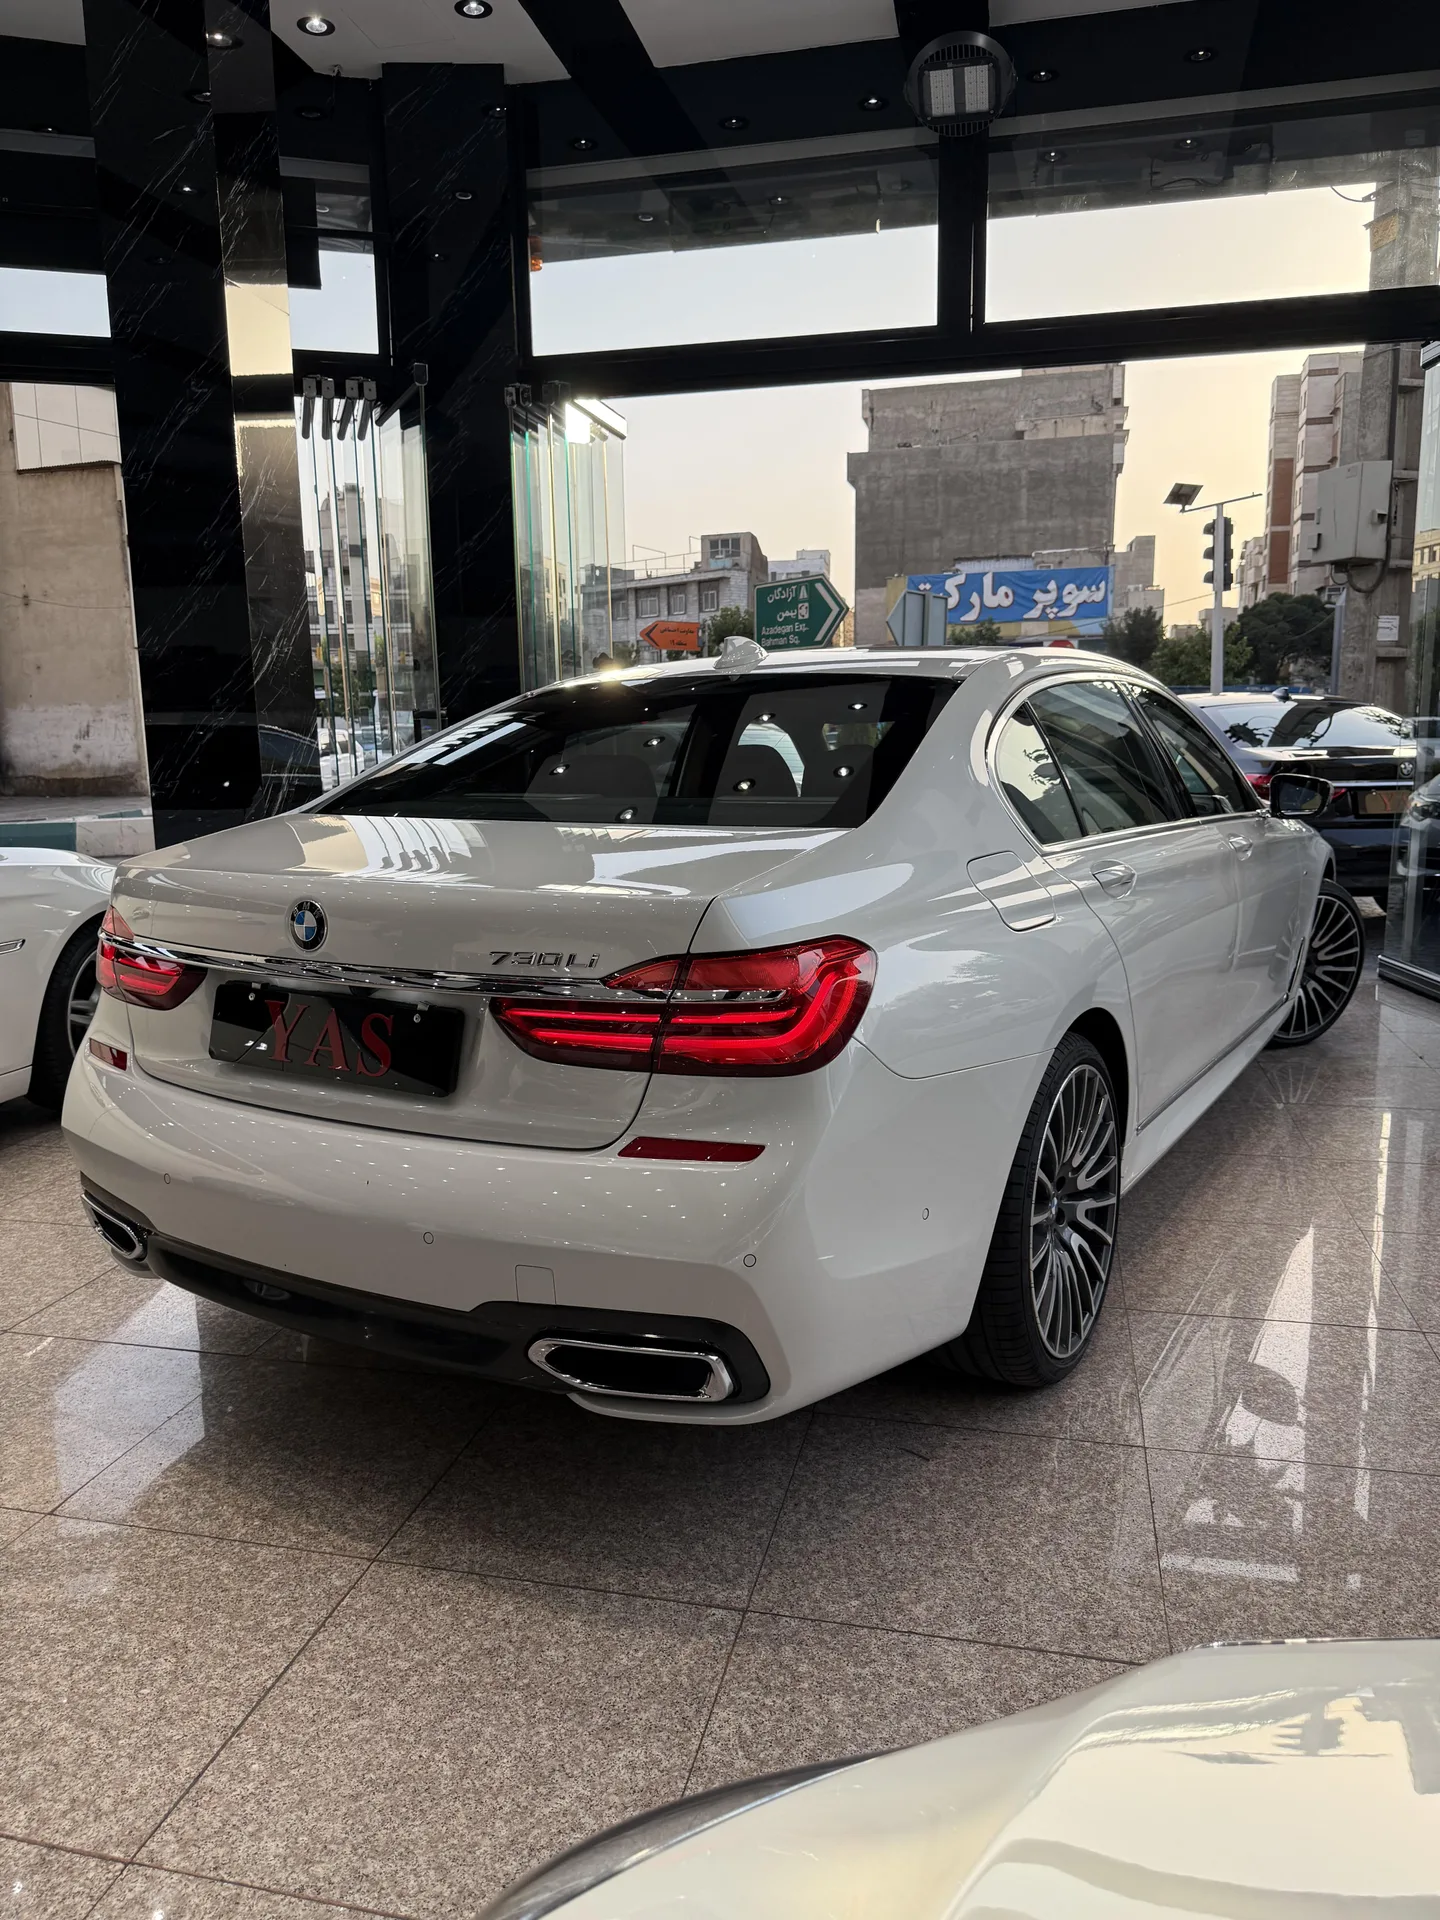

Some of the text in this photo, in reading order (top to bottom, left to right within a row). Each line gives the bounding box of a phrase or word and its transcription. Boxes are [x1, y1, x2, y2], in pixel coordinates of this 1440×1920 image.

[767, 585, 798, 604] آزادگان
[1023, 579, 1106, 620] سوپر
[761, 624, 794, 636] Azadegan
[761, 637, 788, 648] Bahman
[489, 951, 600, 969] 730Li
[265, 1000, 394, 1078] YAS
